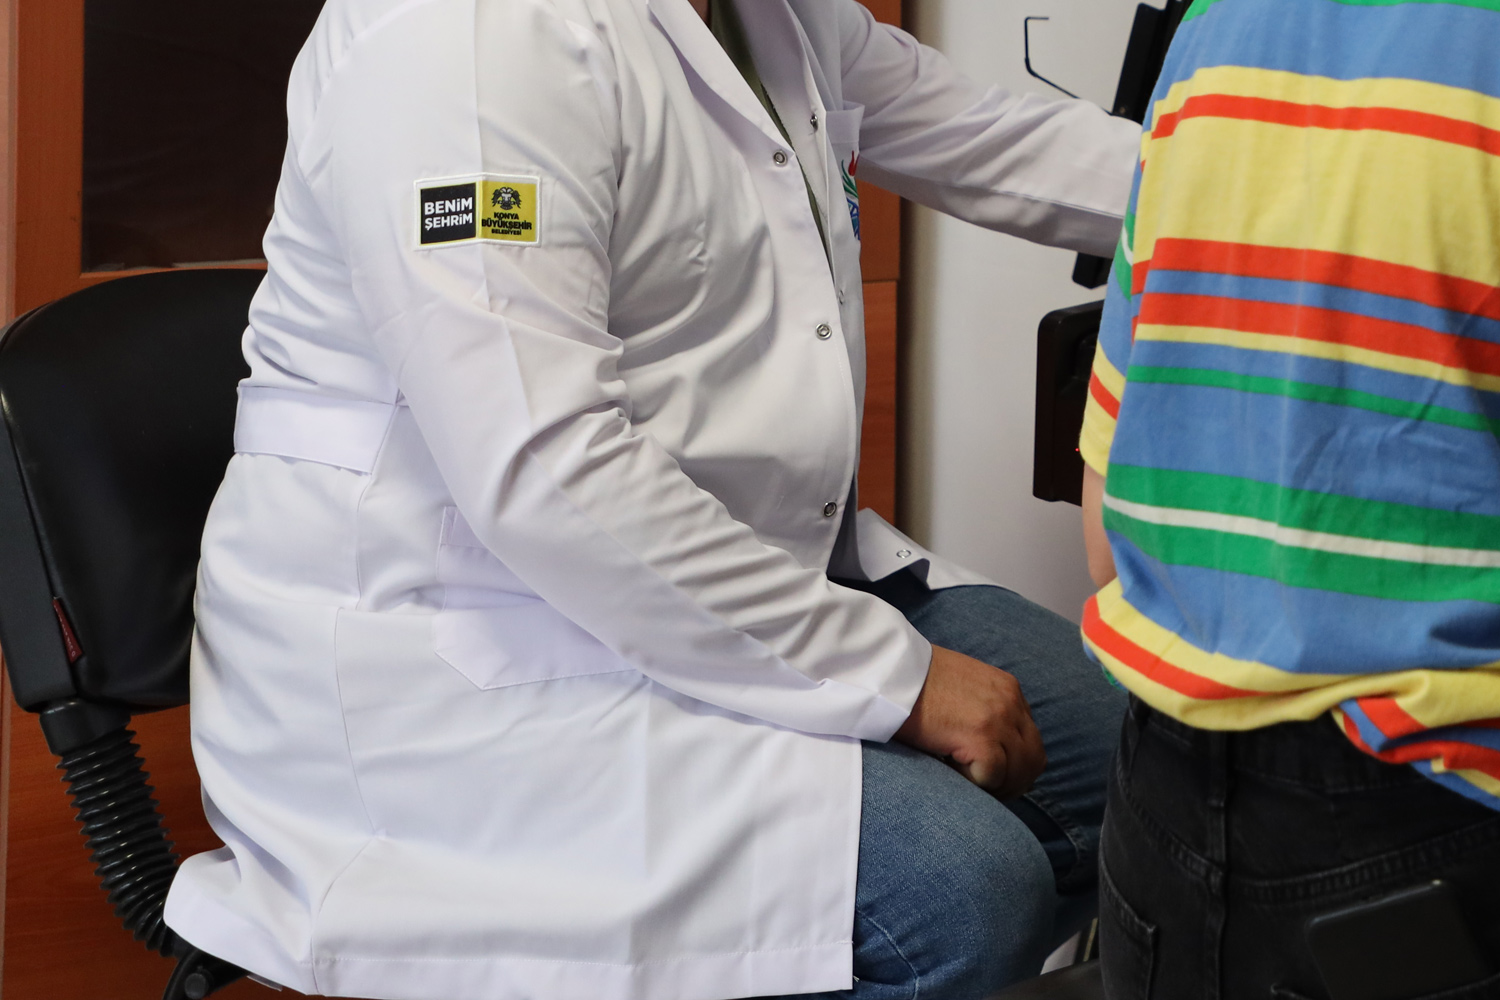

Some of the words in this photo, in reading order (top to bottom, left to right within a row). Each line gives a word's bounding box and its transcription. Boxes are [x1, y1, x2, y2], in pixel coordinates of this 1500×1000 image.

[424, 196, 473, 216] BENİM
[424, 212, 473, 231] ŞEHRİM
[494, 212, 520, 220] KONYA
[482, 218, 532, 230] BÜYÜKŞEHİR
